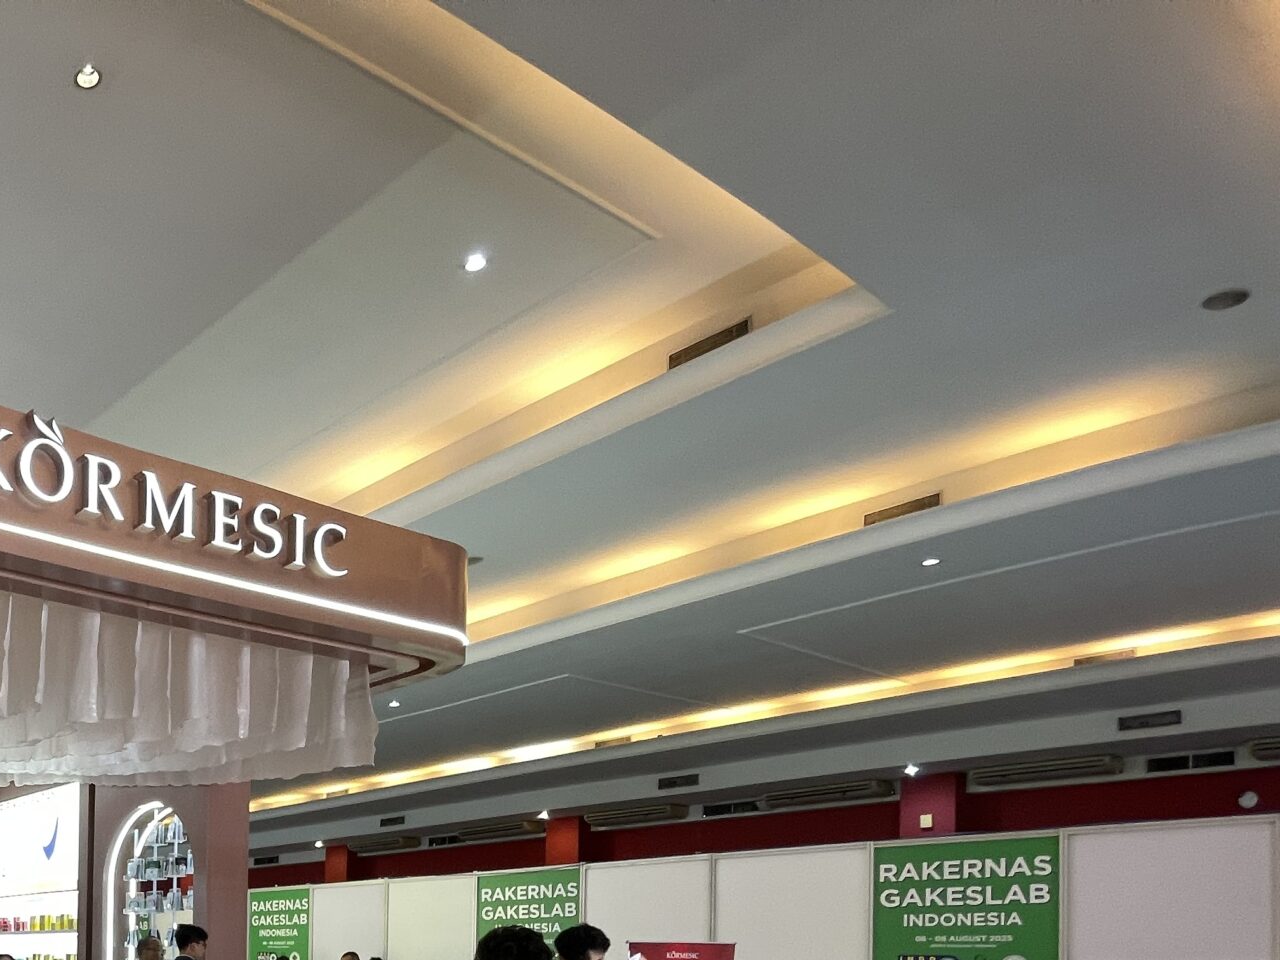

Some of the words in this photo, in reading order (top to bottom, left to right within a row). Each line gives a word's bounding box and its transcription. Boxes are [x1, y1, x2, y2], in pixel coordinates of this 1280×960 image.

[879, 855, 1052, 883] RAKERNAS
[481, 882, 578, 902] RAKERNAS
[880, 883, 1051, 908] GAKESLAB
[251, 898, 309, 912] RAKERNAS
[482, 902, 577, 920] GAKESLAB
[251, 914, 308, 926] GAKESLAB
[903, 911, 1023, 927] INDONESIA
[258, 929, 298, 937] INDONESIA
